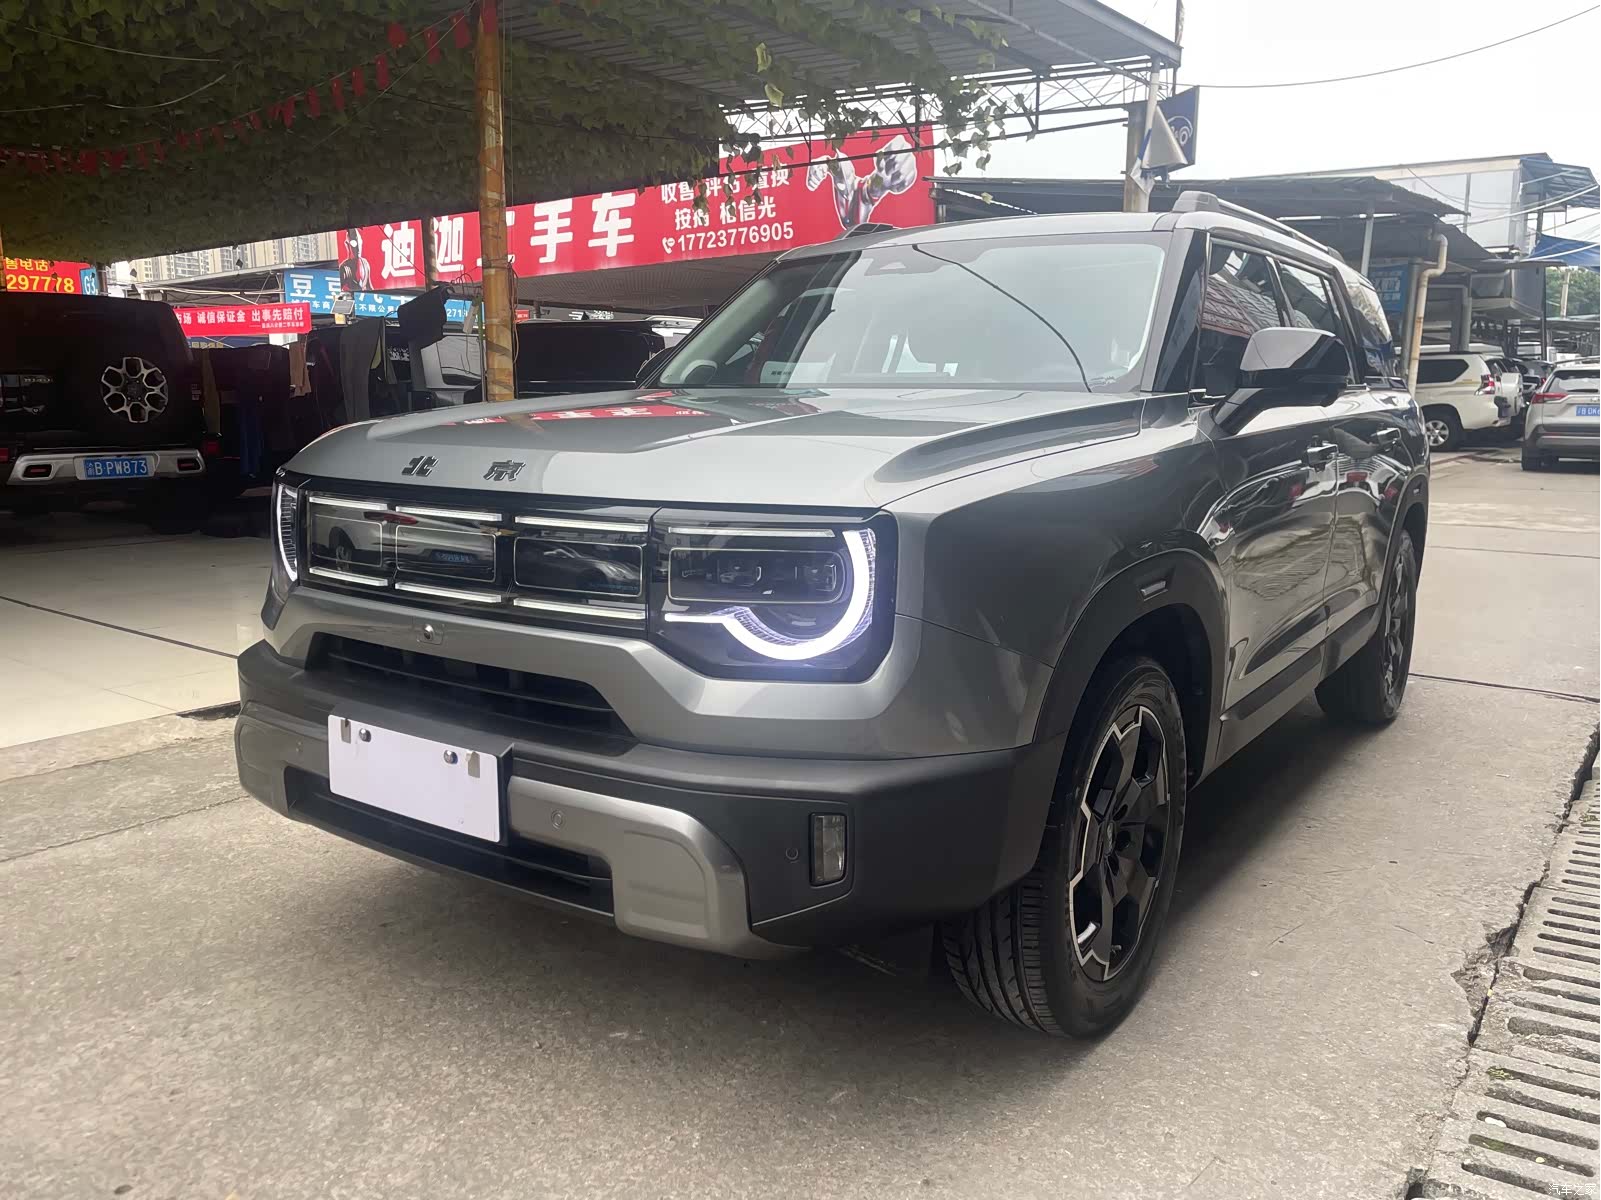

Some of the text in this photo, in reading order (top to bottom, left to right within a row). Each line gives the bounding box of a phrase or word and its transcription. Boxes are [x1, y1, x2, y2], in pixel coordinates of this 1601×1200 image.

[661, 181, 694, 204] 收售
[720, 195, 776, 225] 相信光
[381, 192, 636, 280] 迪迦手车
[678, 221, 794, 252] 17723776905
[197, 310, 246, 324] 诚信保证金
[251, 307, 303, 322] 出事先赔付
[401, 455, 526, 482] 北京
